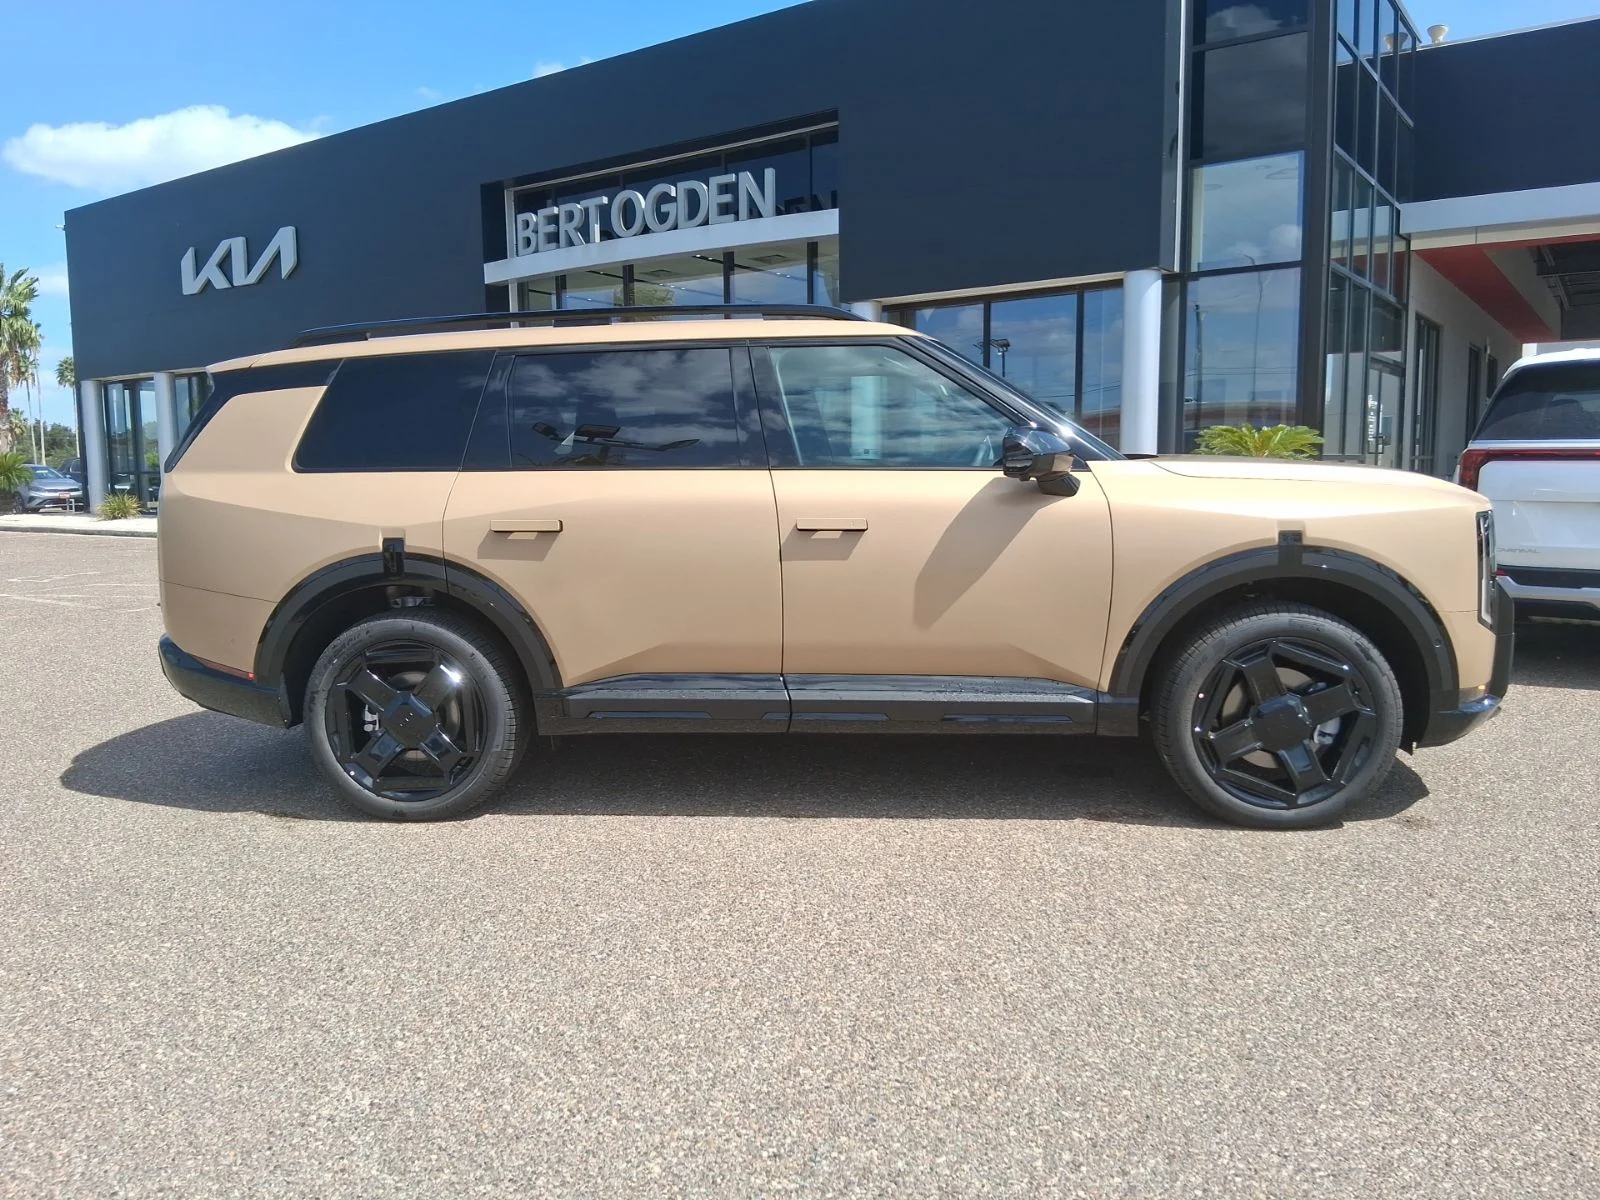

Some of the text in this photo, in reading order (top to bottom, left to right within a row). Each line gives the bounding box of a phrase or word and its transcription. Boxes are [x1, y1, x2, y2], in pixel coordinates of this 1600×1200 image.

[516, 168, 776, 257] BERT OGDEN
[181, 226, 297, 295] KIA
